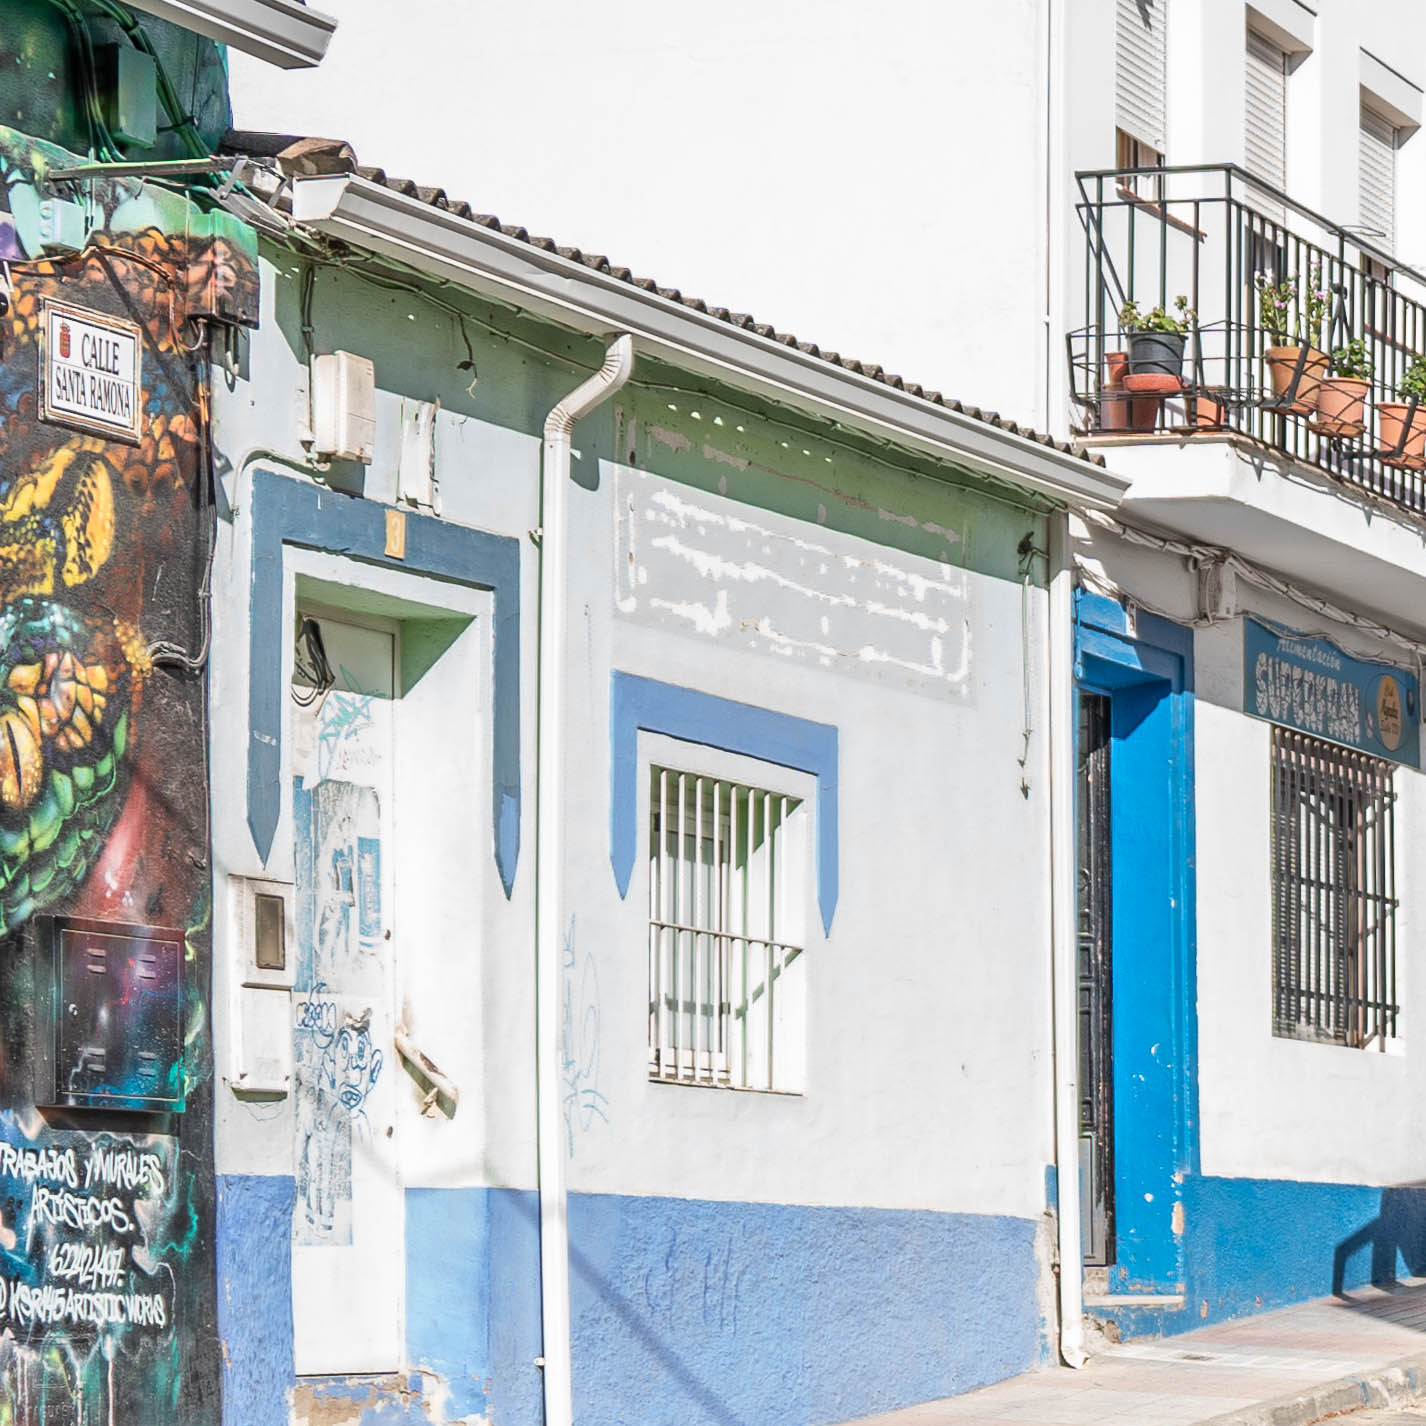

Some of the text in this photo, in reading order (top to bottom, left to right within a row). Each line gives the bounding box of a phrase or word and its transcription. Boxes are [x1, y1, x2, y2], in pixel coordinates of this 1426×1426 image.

[82, 333, 119, 375] CALLE
[56, 366, 131, 419] SANTA RAMONA
